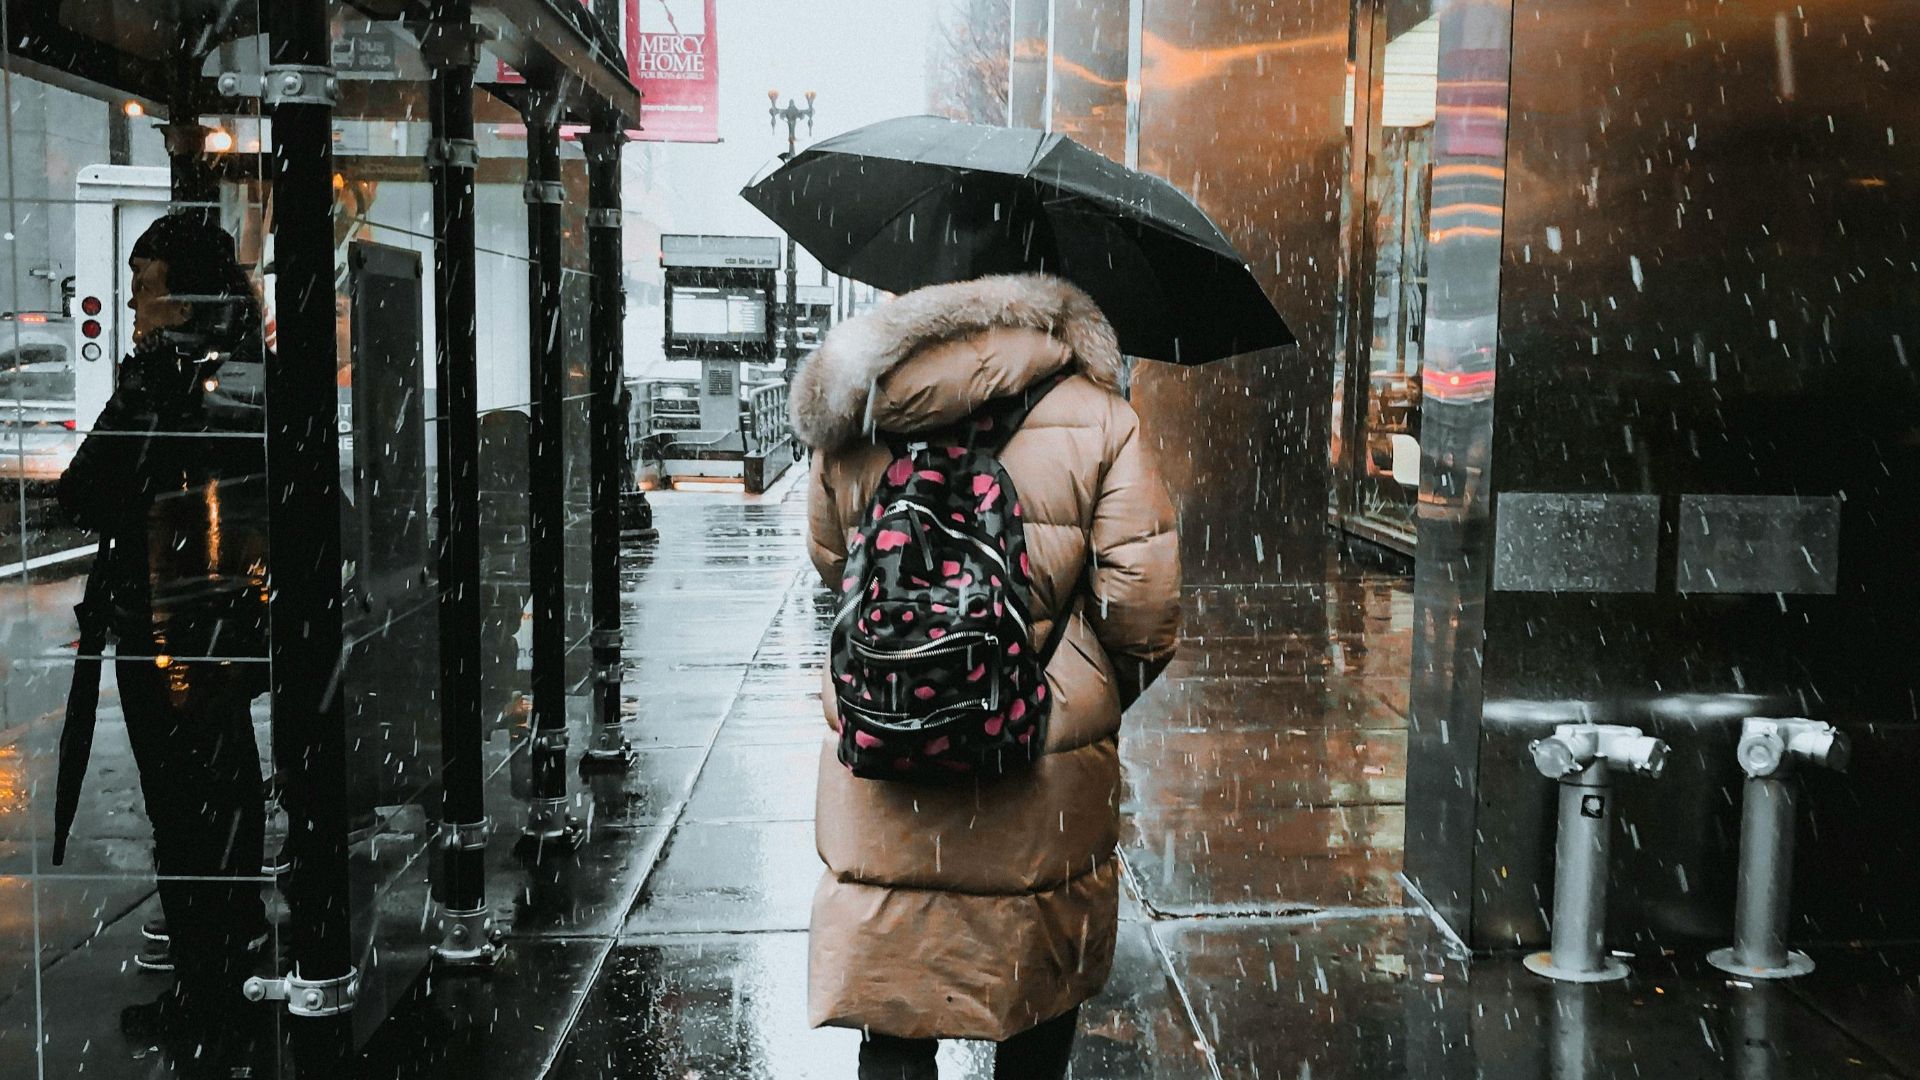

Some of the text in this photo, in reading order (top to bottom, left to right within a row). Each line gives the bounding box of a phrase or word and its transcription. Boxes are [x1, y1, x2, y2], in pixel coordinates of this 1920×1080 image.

[641, 34, 705, 53] MERCY
[640, 53, 705, 71] HOME
[738, 257, 755, 265] Blue
[757, 257, 773, 265] Line
